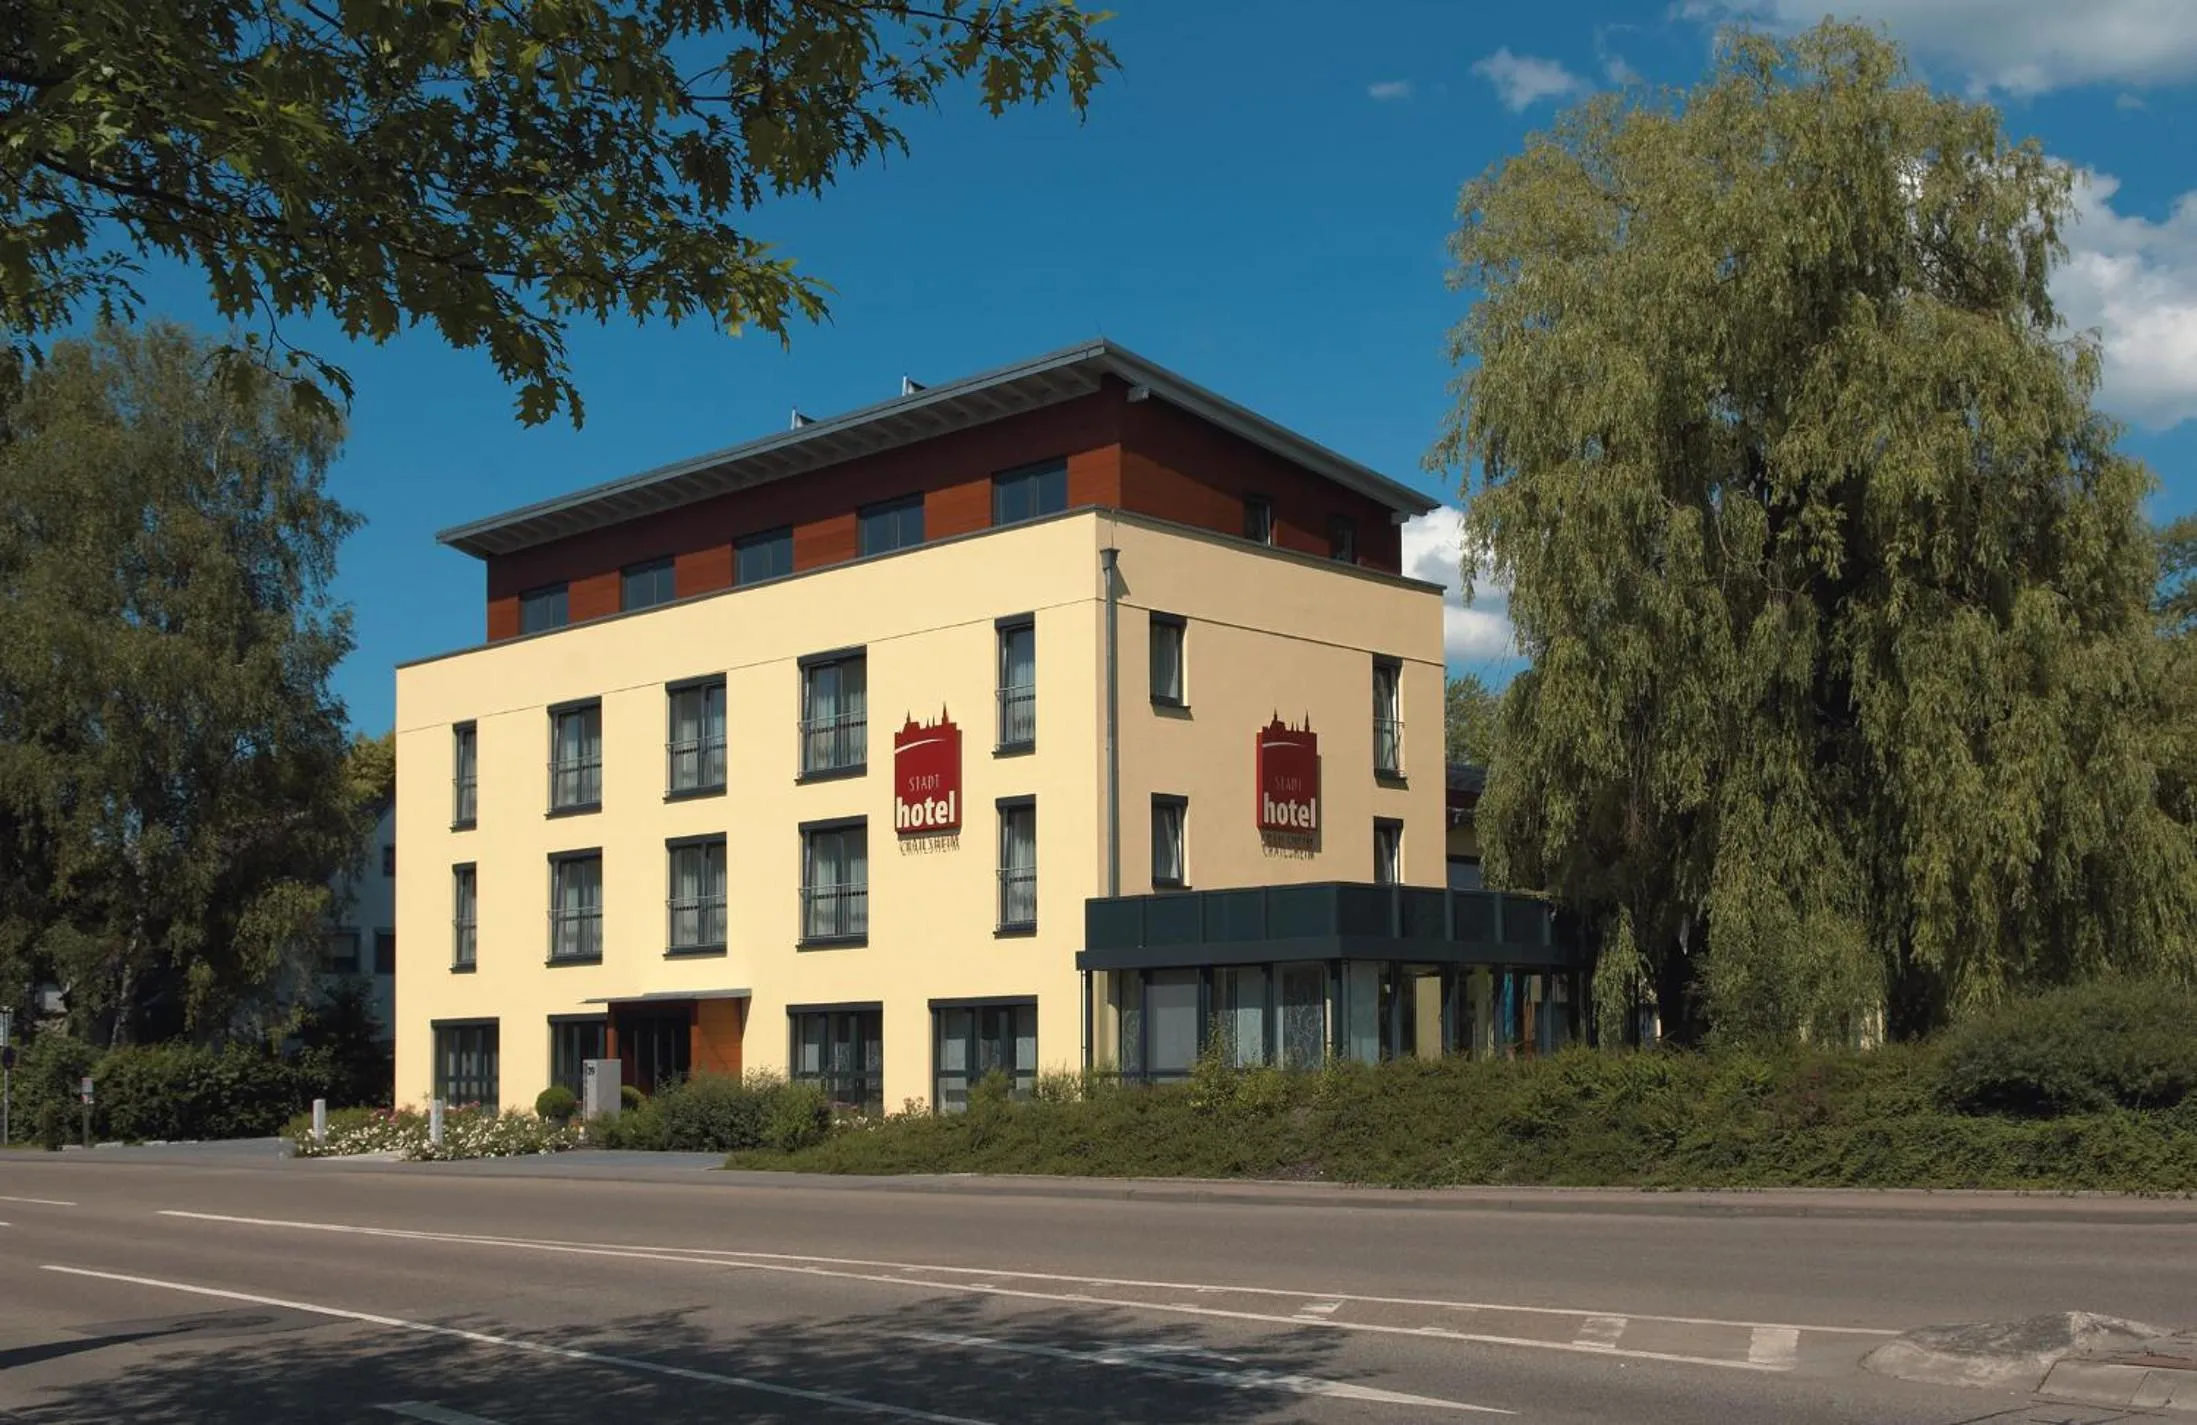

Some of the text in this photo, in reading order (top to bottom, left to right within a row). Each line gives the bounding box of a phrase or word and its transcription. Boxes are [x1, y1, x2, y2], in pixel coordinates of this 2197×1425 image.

[908, 773, 940, 792] STADT
[896, 790, 956, 828] hotel
[1263, 791, 1317, 829] hotel
